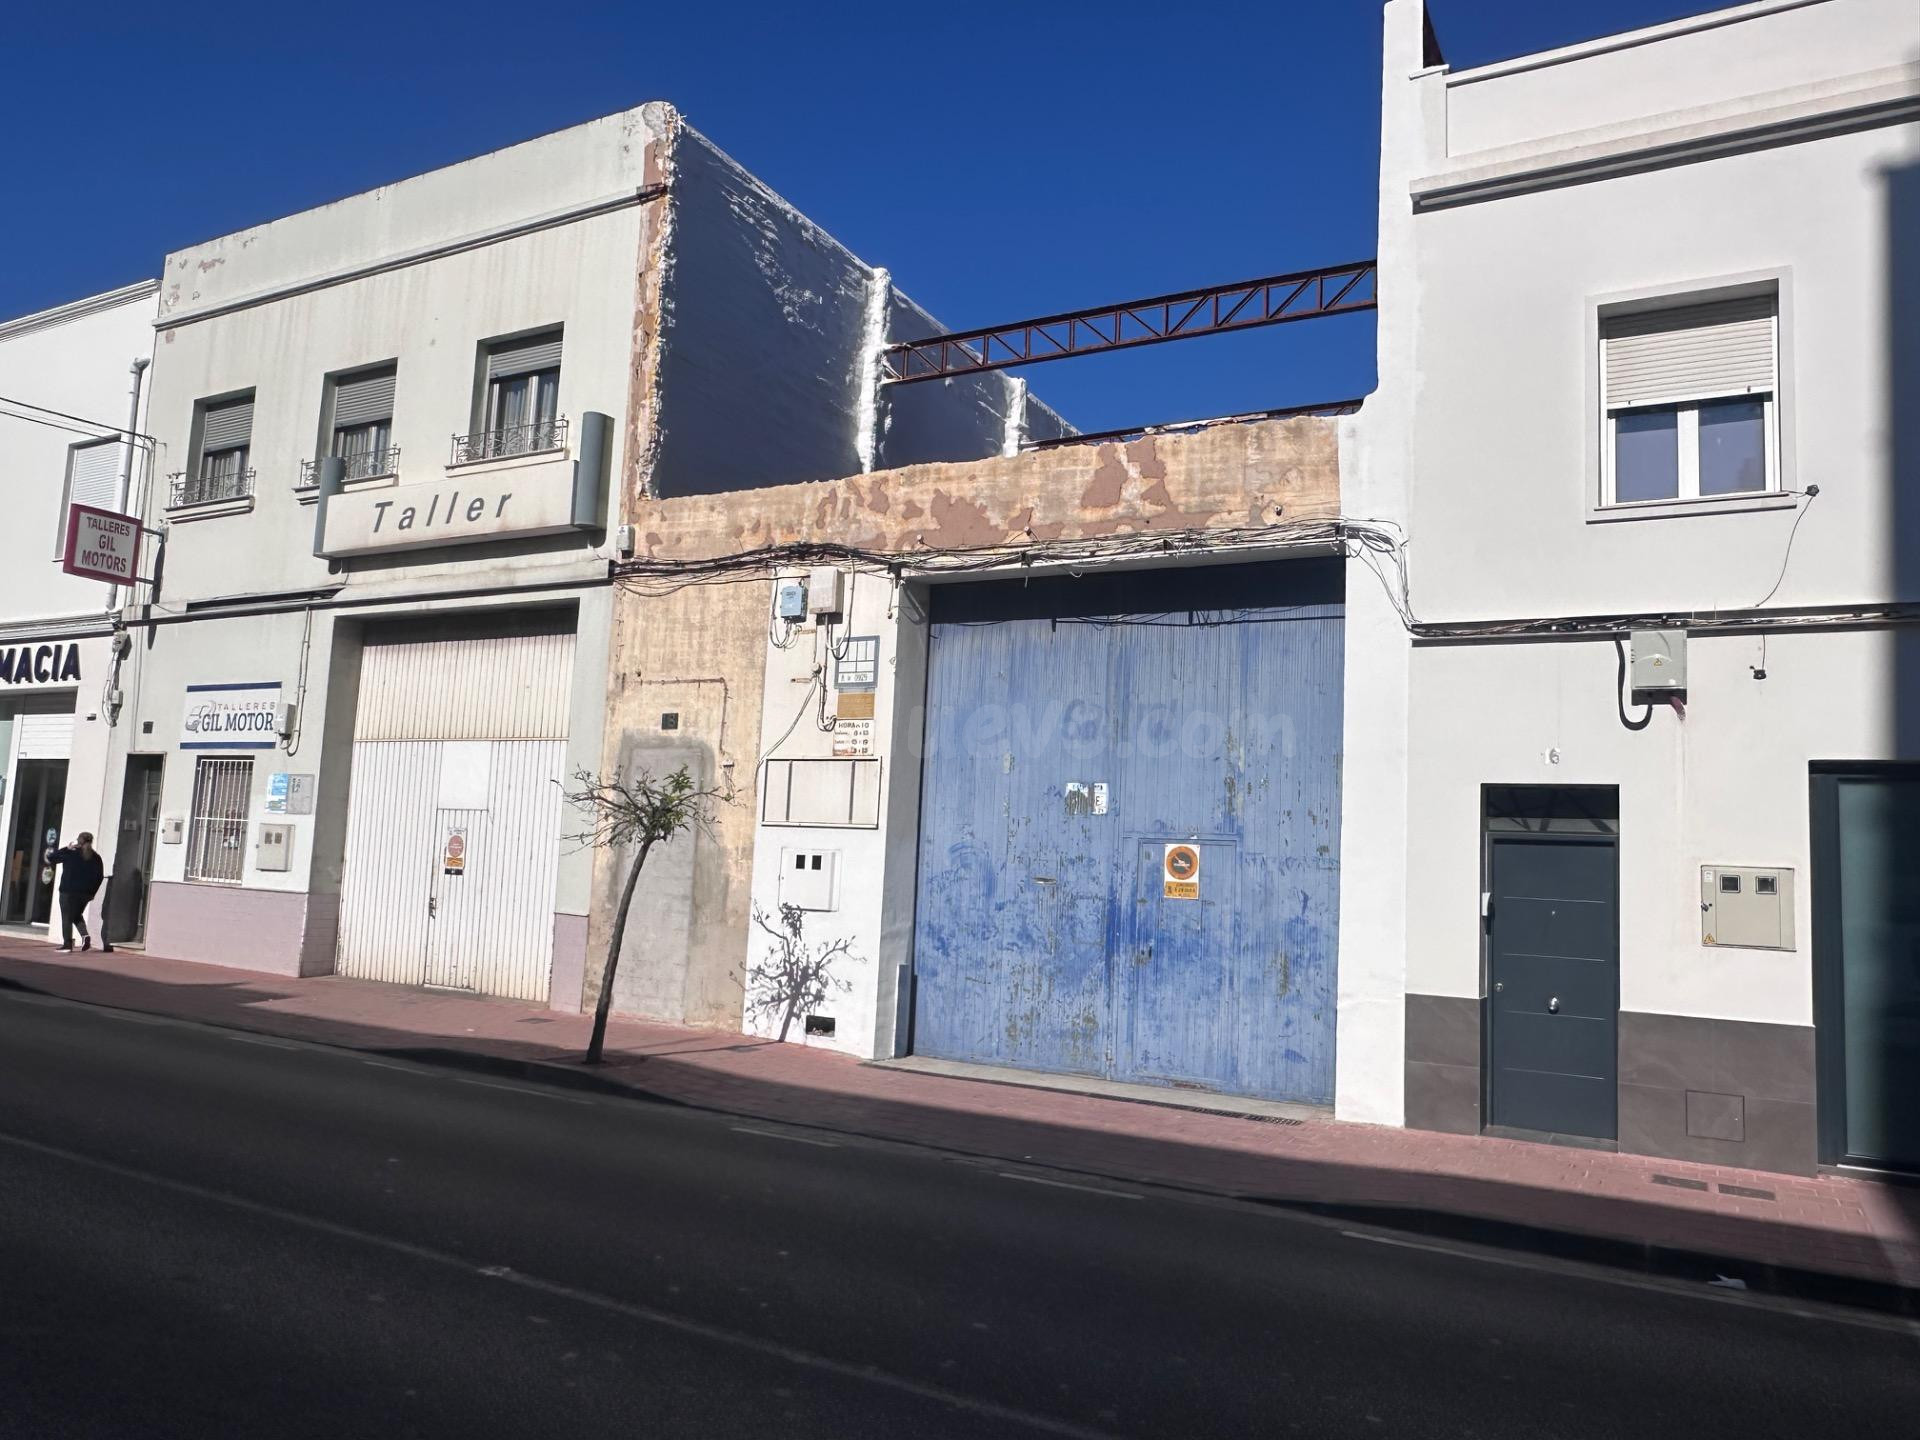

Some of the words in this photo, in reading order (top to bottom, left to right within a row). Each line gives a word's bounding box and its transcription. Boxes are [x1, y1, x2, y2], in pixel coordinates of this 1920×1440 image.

[373, 491, 512, 533] Taller
[87, 516, 130, 536] TALLERES
[98, 534, 116, 552] GIL
[81, 549, 127, 573] MOTORS
[217, 702, 276, 711] TALLERES
[201, 713, 222, 732] GIL
[224, 712, 274, 731] MOTOR
[1549, 748, 1560, 765] 6
